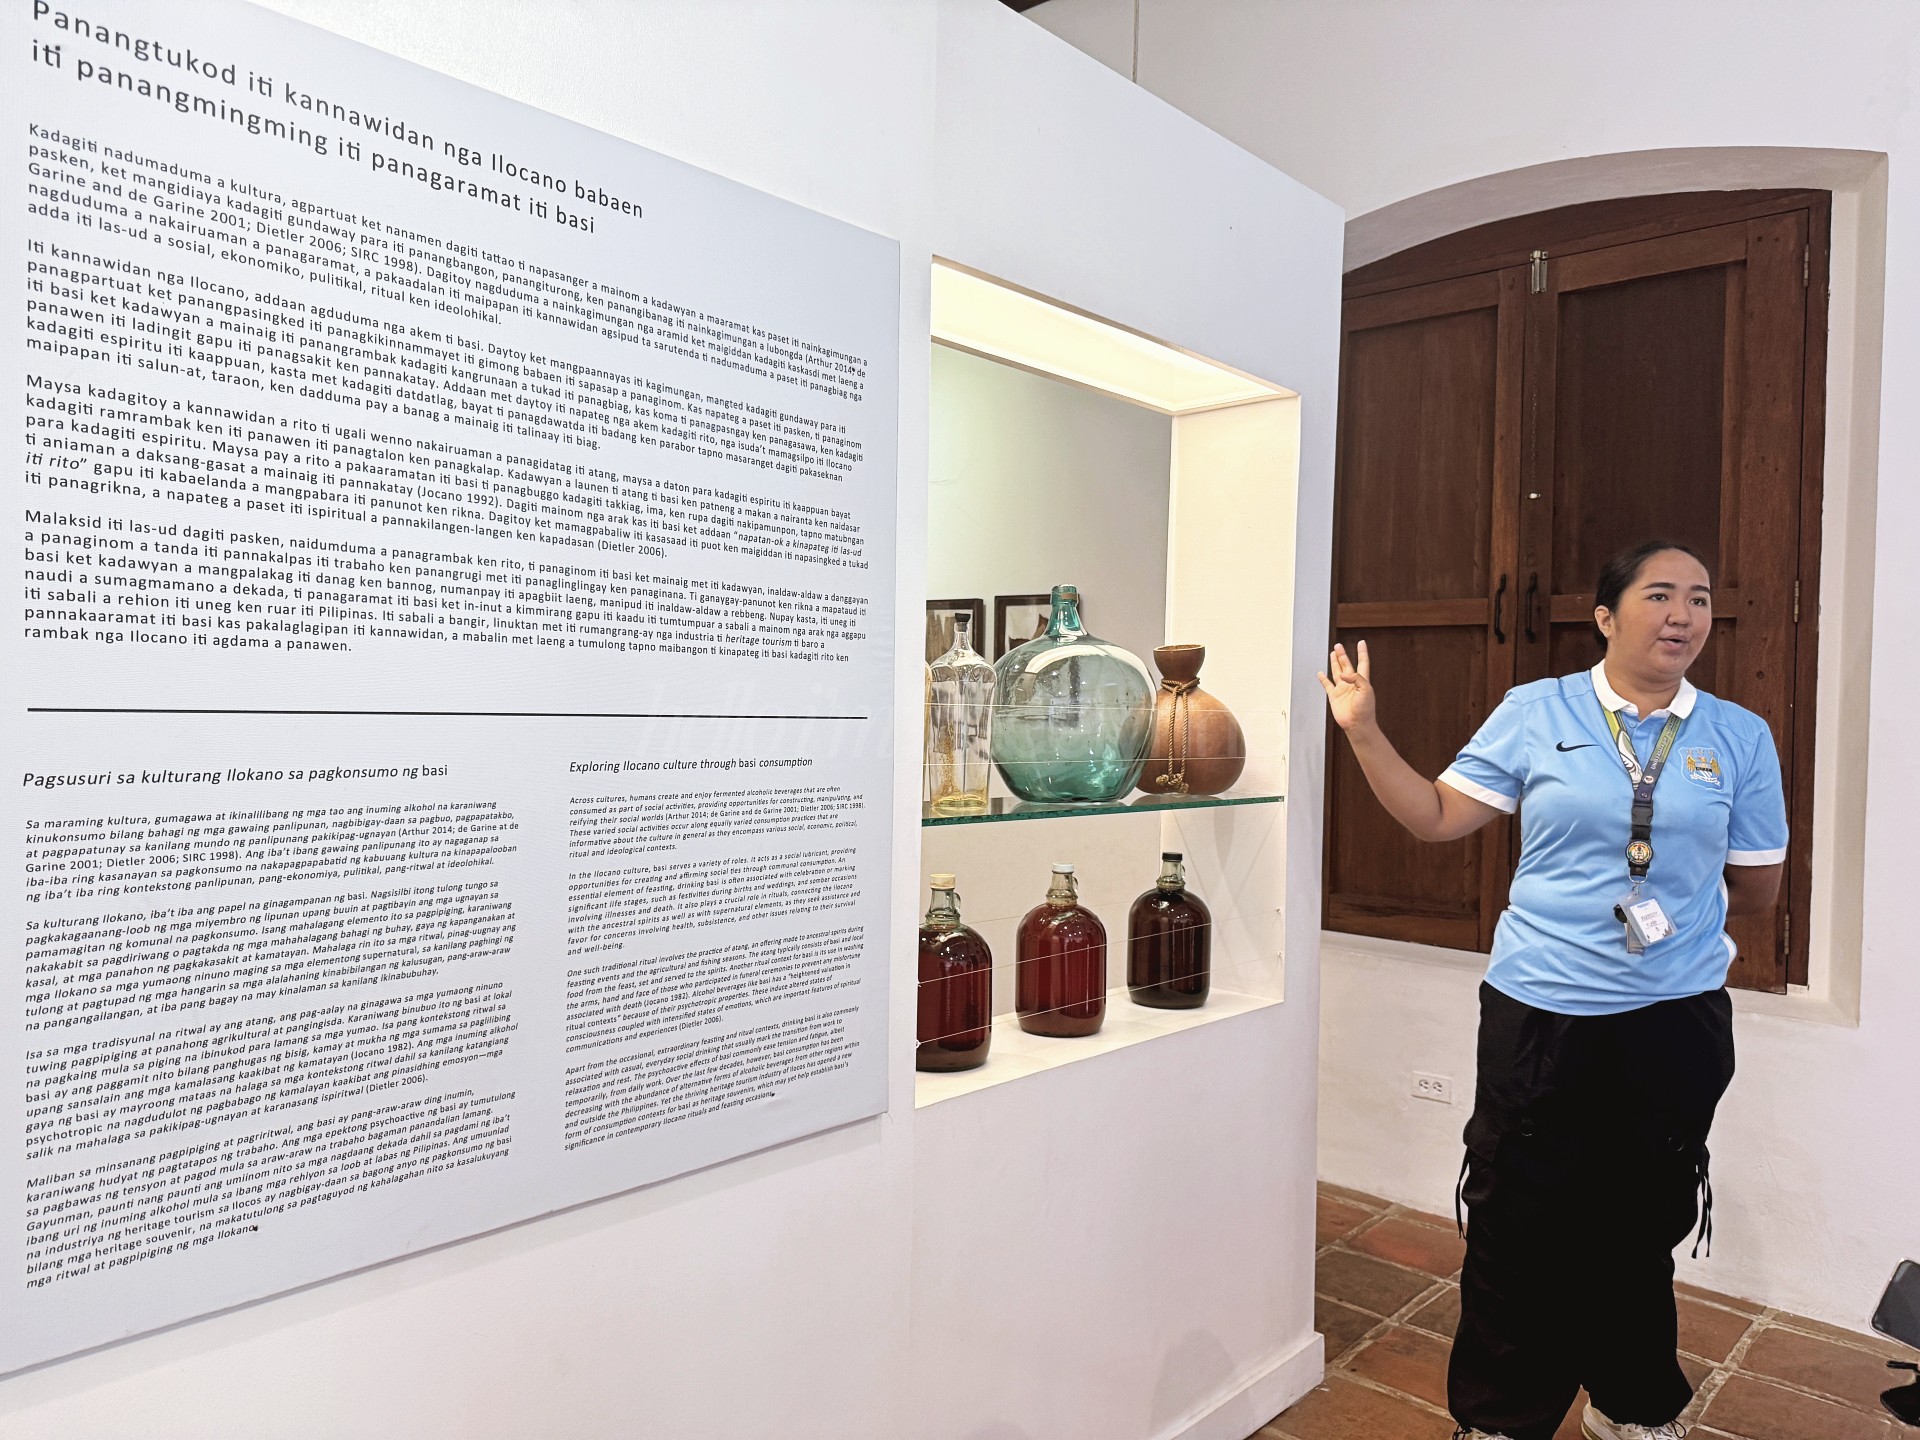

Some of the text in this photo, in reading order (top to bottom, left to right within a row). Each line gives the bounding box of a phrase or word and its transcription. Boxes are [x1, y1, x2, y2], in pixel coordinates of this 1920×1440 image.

[33, 39, 594, 234] iti panangmingming iti panagaramat iti basi
[34, 0, 642, 219] Panangtukod iti kannawidan nga Ilocano babaen
[28, 203, 501, 325] adda iti las-ud a sosial, ekonomiko, pulitikal, ritual ken ideolohikal.
[27, 338, 601, 451] maipapan iti salun-at, taraon, ken dadduma pay a banag a mainaig iti talinaay iti biag.
[27, 315, 843, 482] kadagiti espiritu iti kaappuan, kasta met kadagiti datdatlag, bayat ti panagdawatda iti badang ken parabor tapno masaranget dagiti pakaseknan
[26, 471, 667, 559] iti panagrikna, a napateg a paset iti ispiritual a pannakilangen-langen ken kapadasan (Dietler 2006).
[25, 626, 352, 651] rambak nga Ilocano iti agdama a panawen.
[23, 764, 448, 789] Pagsusuri sa kulturang Ilokano sa pagkonsumo ng basi
[569, 757, 813, 774] Exploring Ilocano culture through basi consumption
[26, 894, 41, 903] ng
[76, 888, 94, 897] iba
[97, 886, 120, 897] ring
[123, 882, 192, 894] kontekstong
[194, 877, 255, 890] panlipunan,
[258, 870, 341, 885] pang-ekonomiya,
[343, 866, 382, 878] pulitikal,
[384, 861, 435, 875] pang-ritwal
[436, 861, 445, 869] at
[447, 857, 494, 868] ideolohikal.
[569, 844, 677, 858] ritual and ideological contexts.
[567, 942, 624, 956] and well-being.
[565, 1015, 723, 1053] communications and experiences (Dietler 2006).
[26, 1074, 428, 1160] salik na mahalaga sa pakikipag-ugnayan at karanasang ispiritwal (Dietler 2006).
[26, 1088, 474, 1189] Maliban sa minsanang pagpipiging at pagriritwal, ang basi ay pang-araw-araw ding inumin,
[564, 1135, 606, 1151] significance
[615, 1121, 662, 1138] contemporary
[663, 1114, 686, 1125] Ilocano
[687, 1107, 707, 1118] rituals
[708, 1103, 720, 1113] and
[721, 1098, 744, 1109] feasting
